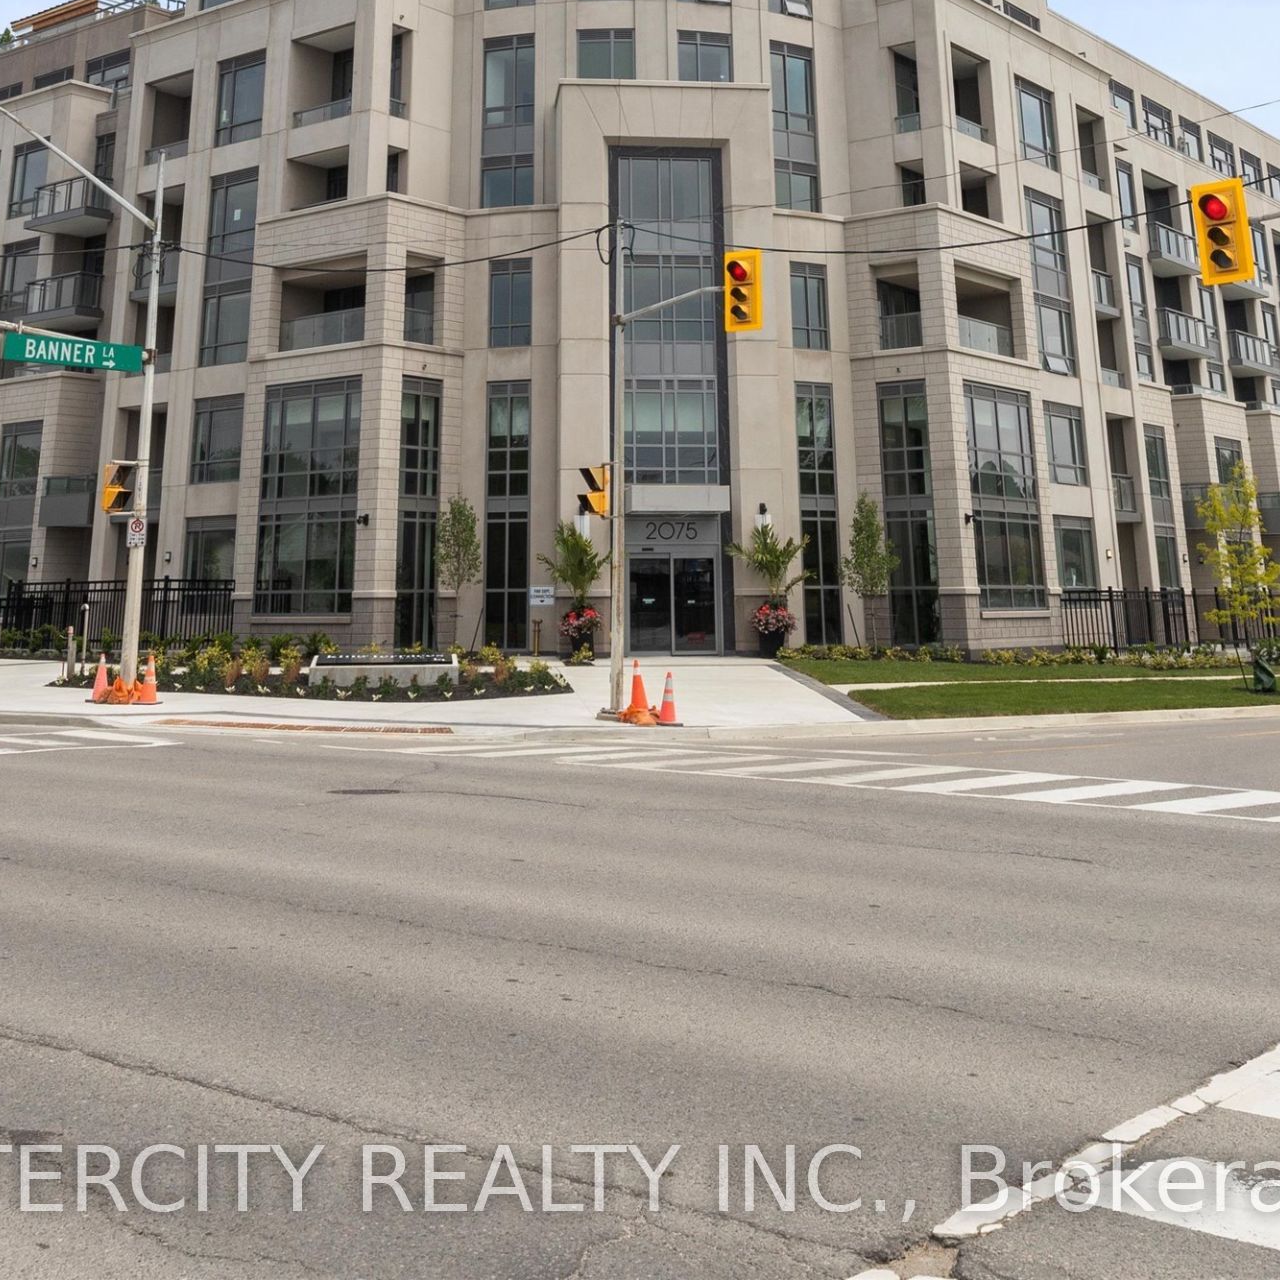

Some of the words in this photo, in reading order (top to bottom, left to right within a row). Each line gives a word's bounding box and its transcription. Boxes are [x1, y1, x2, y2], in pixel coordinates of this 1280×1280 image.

[24, 338, 96, 365] BANNER
[102, 346, 115, 358] LA
[645, 521, 698, 540] 2075
